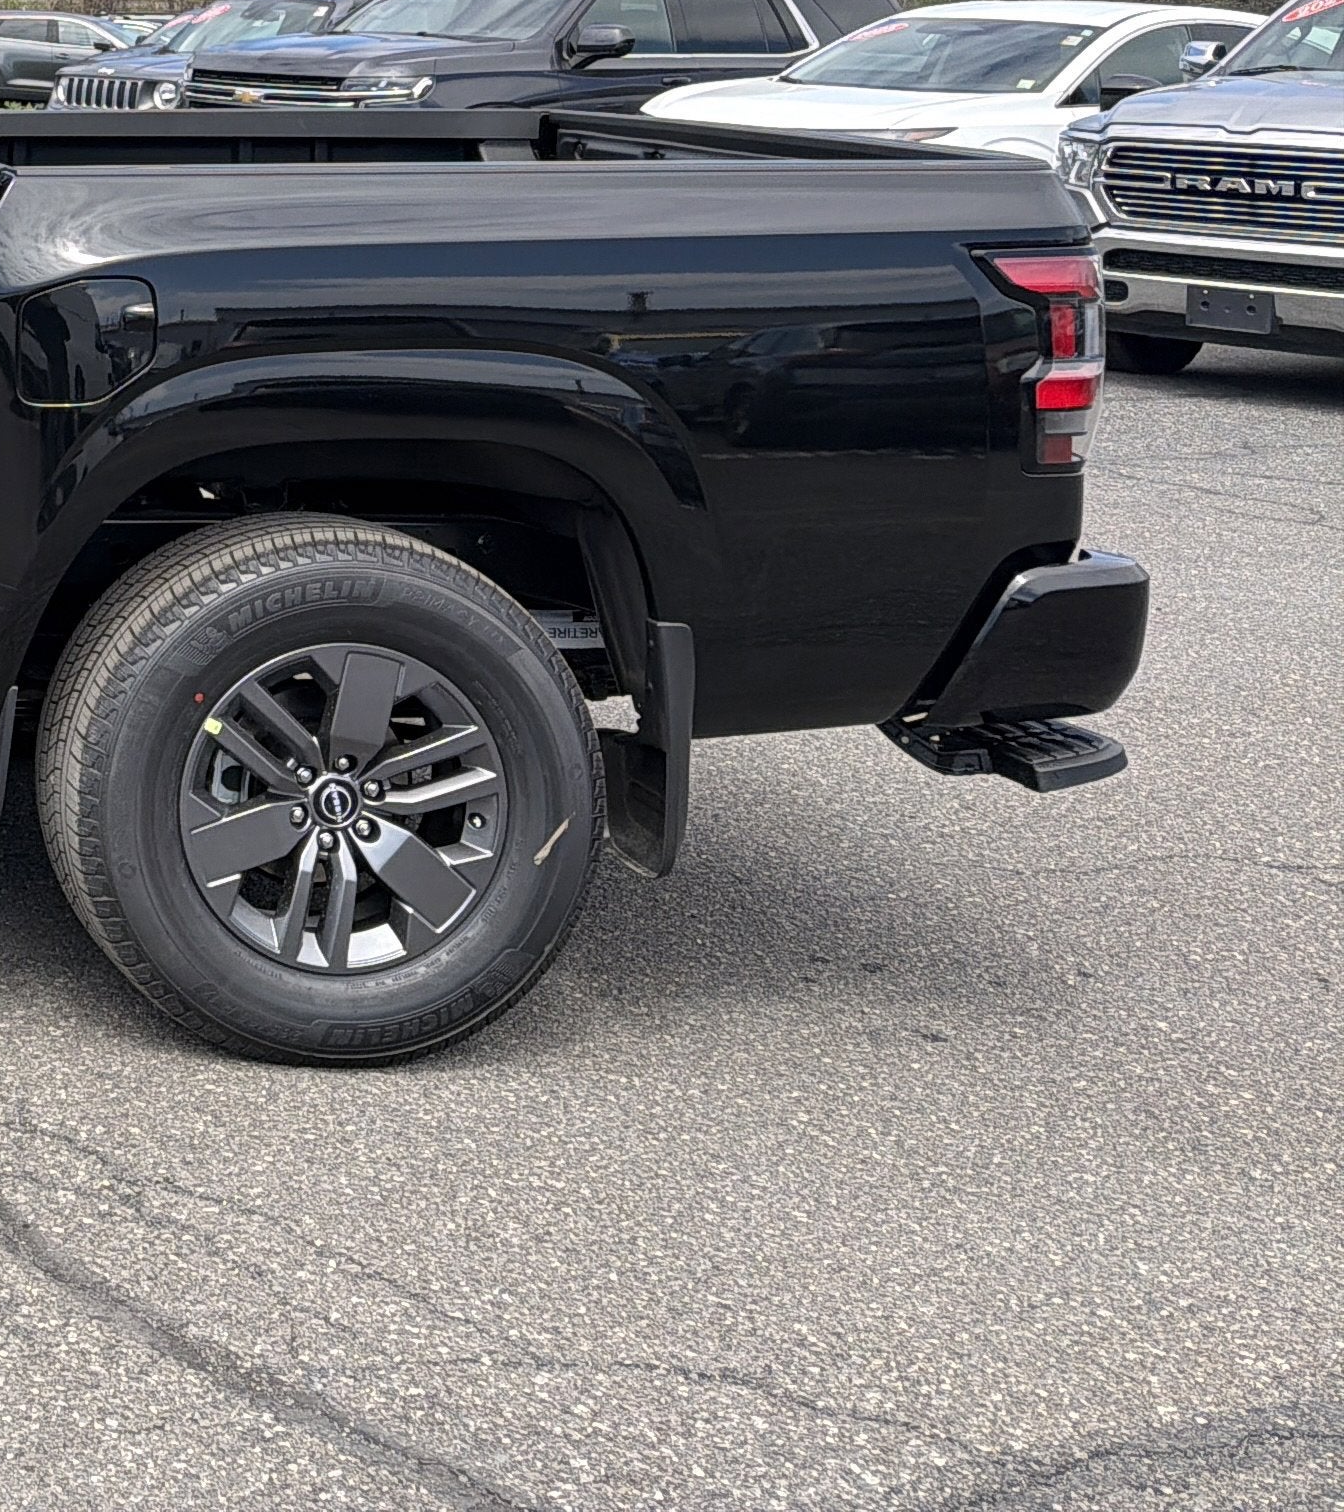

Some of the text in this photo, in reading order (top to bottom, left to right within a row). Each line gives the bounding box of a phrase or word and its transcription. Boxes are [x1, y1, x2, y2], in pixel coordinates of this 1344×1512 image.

[1175, 173, 1295, 198] RAM
[227, 575, 376, 631] MICHELIN
[329, 992, 475, 1046] MICHELIN
